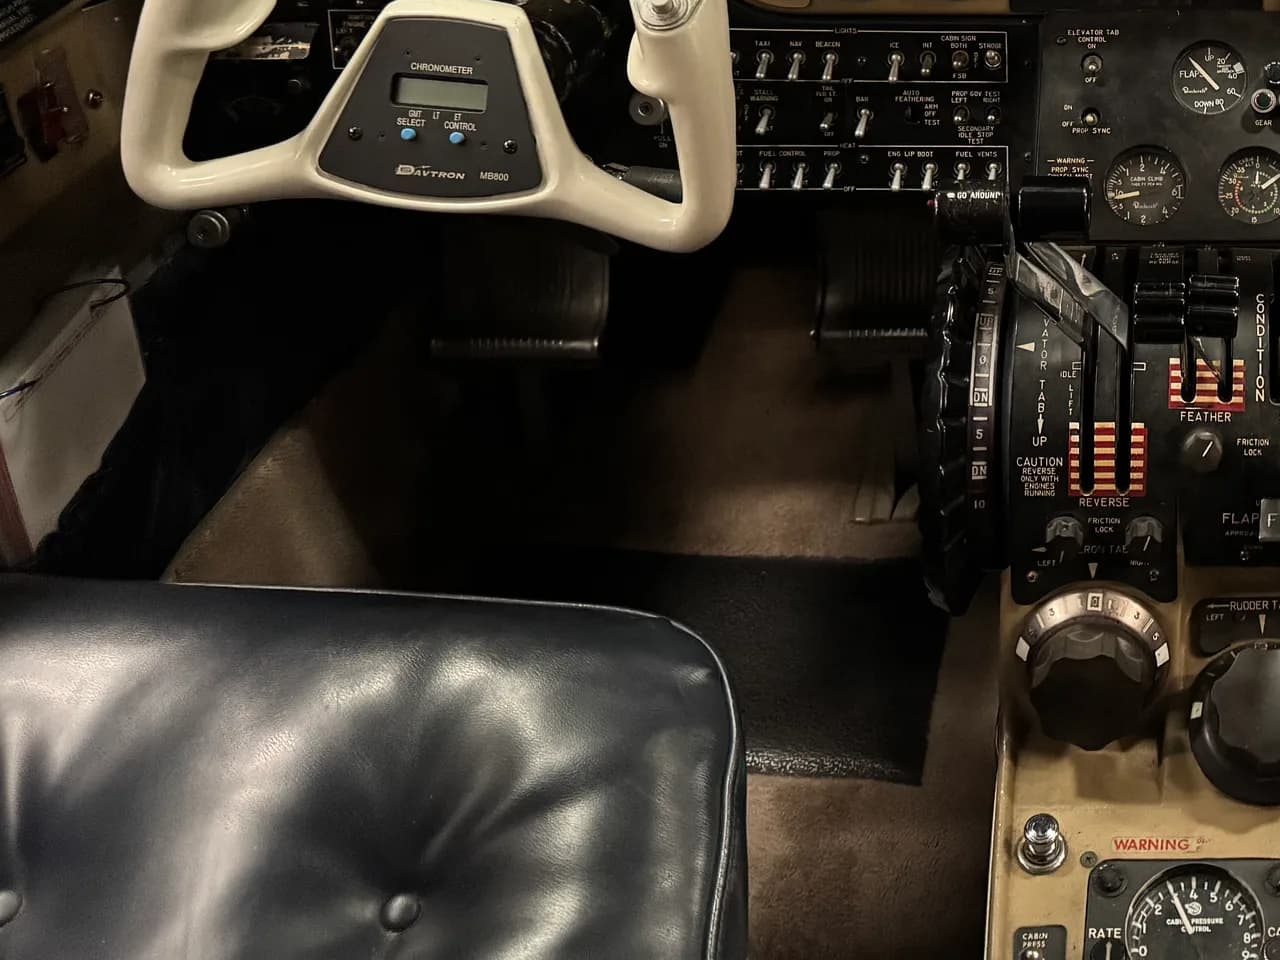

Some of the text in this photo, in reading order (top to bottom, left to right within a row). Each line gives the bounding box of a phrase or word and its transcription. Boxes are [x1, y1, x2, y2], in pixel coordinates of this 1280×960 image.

[410, 62, 474, 76] CHRONOMETER
[1084, 76, 1097, 84] OFF
[895, 95, 935, 103] FEATHERING
[1194, 100, 1214, 108] DOWN
[408, 109, 462, 122] GMT LT ET
[396, 117, 426, 127] SELECT
[444, 121, 478, 132] CONTROL
[1254, 119, 1273, 127] GEAR
[957, 125, 995, 133] SECONDARY
[1092, 127, 1111, 135] SYNC
[977, 131, 994, 139] STOP
[1051, 166, 1069, 174] PROP
[1255, 293, 1266, 403] CONDITION
[1060, 369, 1077, 378] IDLE
[973, 391, 988, 402] DN
[1180, 411, 1232, 423] FEATHER
[1032, 436, 1048, 447] UP
[1236, 438, 1270, 447] FRICTION
[1243, 447, 1263, 457] LOCK
[1016, 456, 1064, 468] CAUTION
[971, 464, 988, 475] DN
[1022, 467, 1056, 476] REVERSE
[1020, 474, 1059, 483] ONLY WITH
[1024, 482, 1055, 491] ENGINES
[1024, 489, 1056, 498] RUNNING
[973, 499, 985, 509] 10
[1079, 497, 1131, 508] REVERSE
[1087, 517, 1121, 525] FRICTION
[1094, 526, 1114, 534] LOCK
[1037, 559, 1056, 568] LEFT
[1229, 599, 1270, 612] RUDDER
[1205, 613, 1225, 622] LEFT
[1114, 837, 1190, 851] WARNING
[1189, 890, 1198, 903] 4
[1209, 891, 1218, 904] 5
[1154, 904, 1163, 916] 2
[1225, 900, 1234, 912] 6
[1190, 917, 1224, 925] PRESSURE
[1238, 914, 1246, 926] 7
[1022, 931, 1048, 940] CABIN
[1088, 928, 1122, 939] RATE
[1243, 931, 1252, 944] 8
[1022, 939, 1047, 949] PRESS
[1138, 945, 1147, 958] 0
